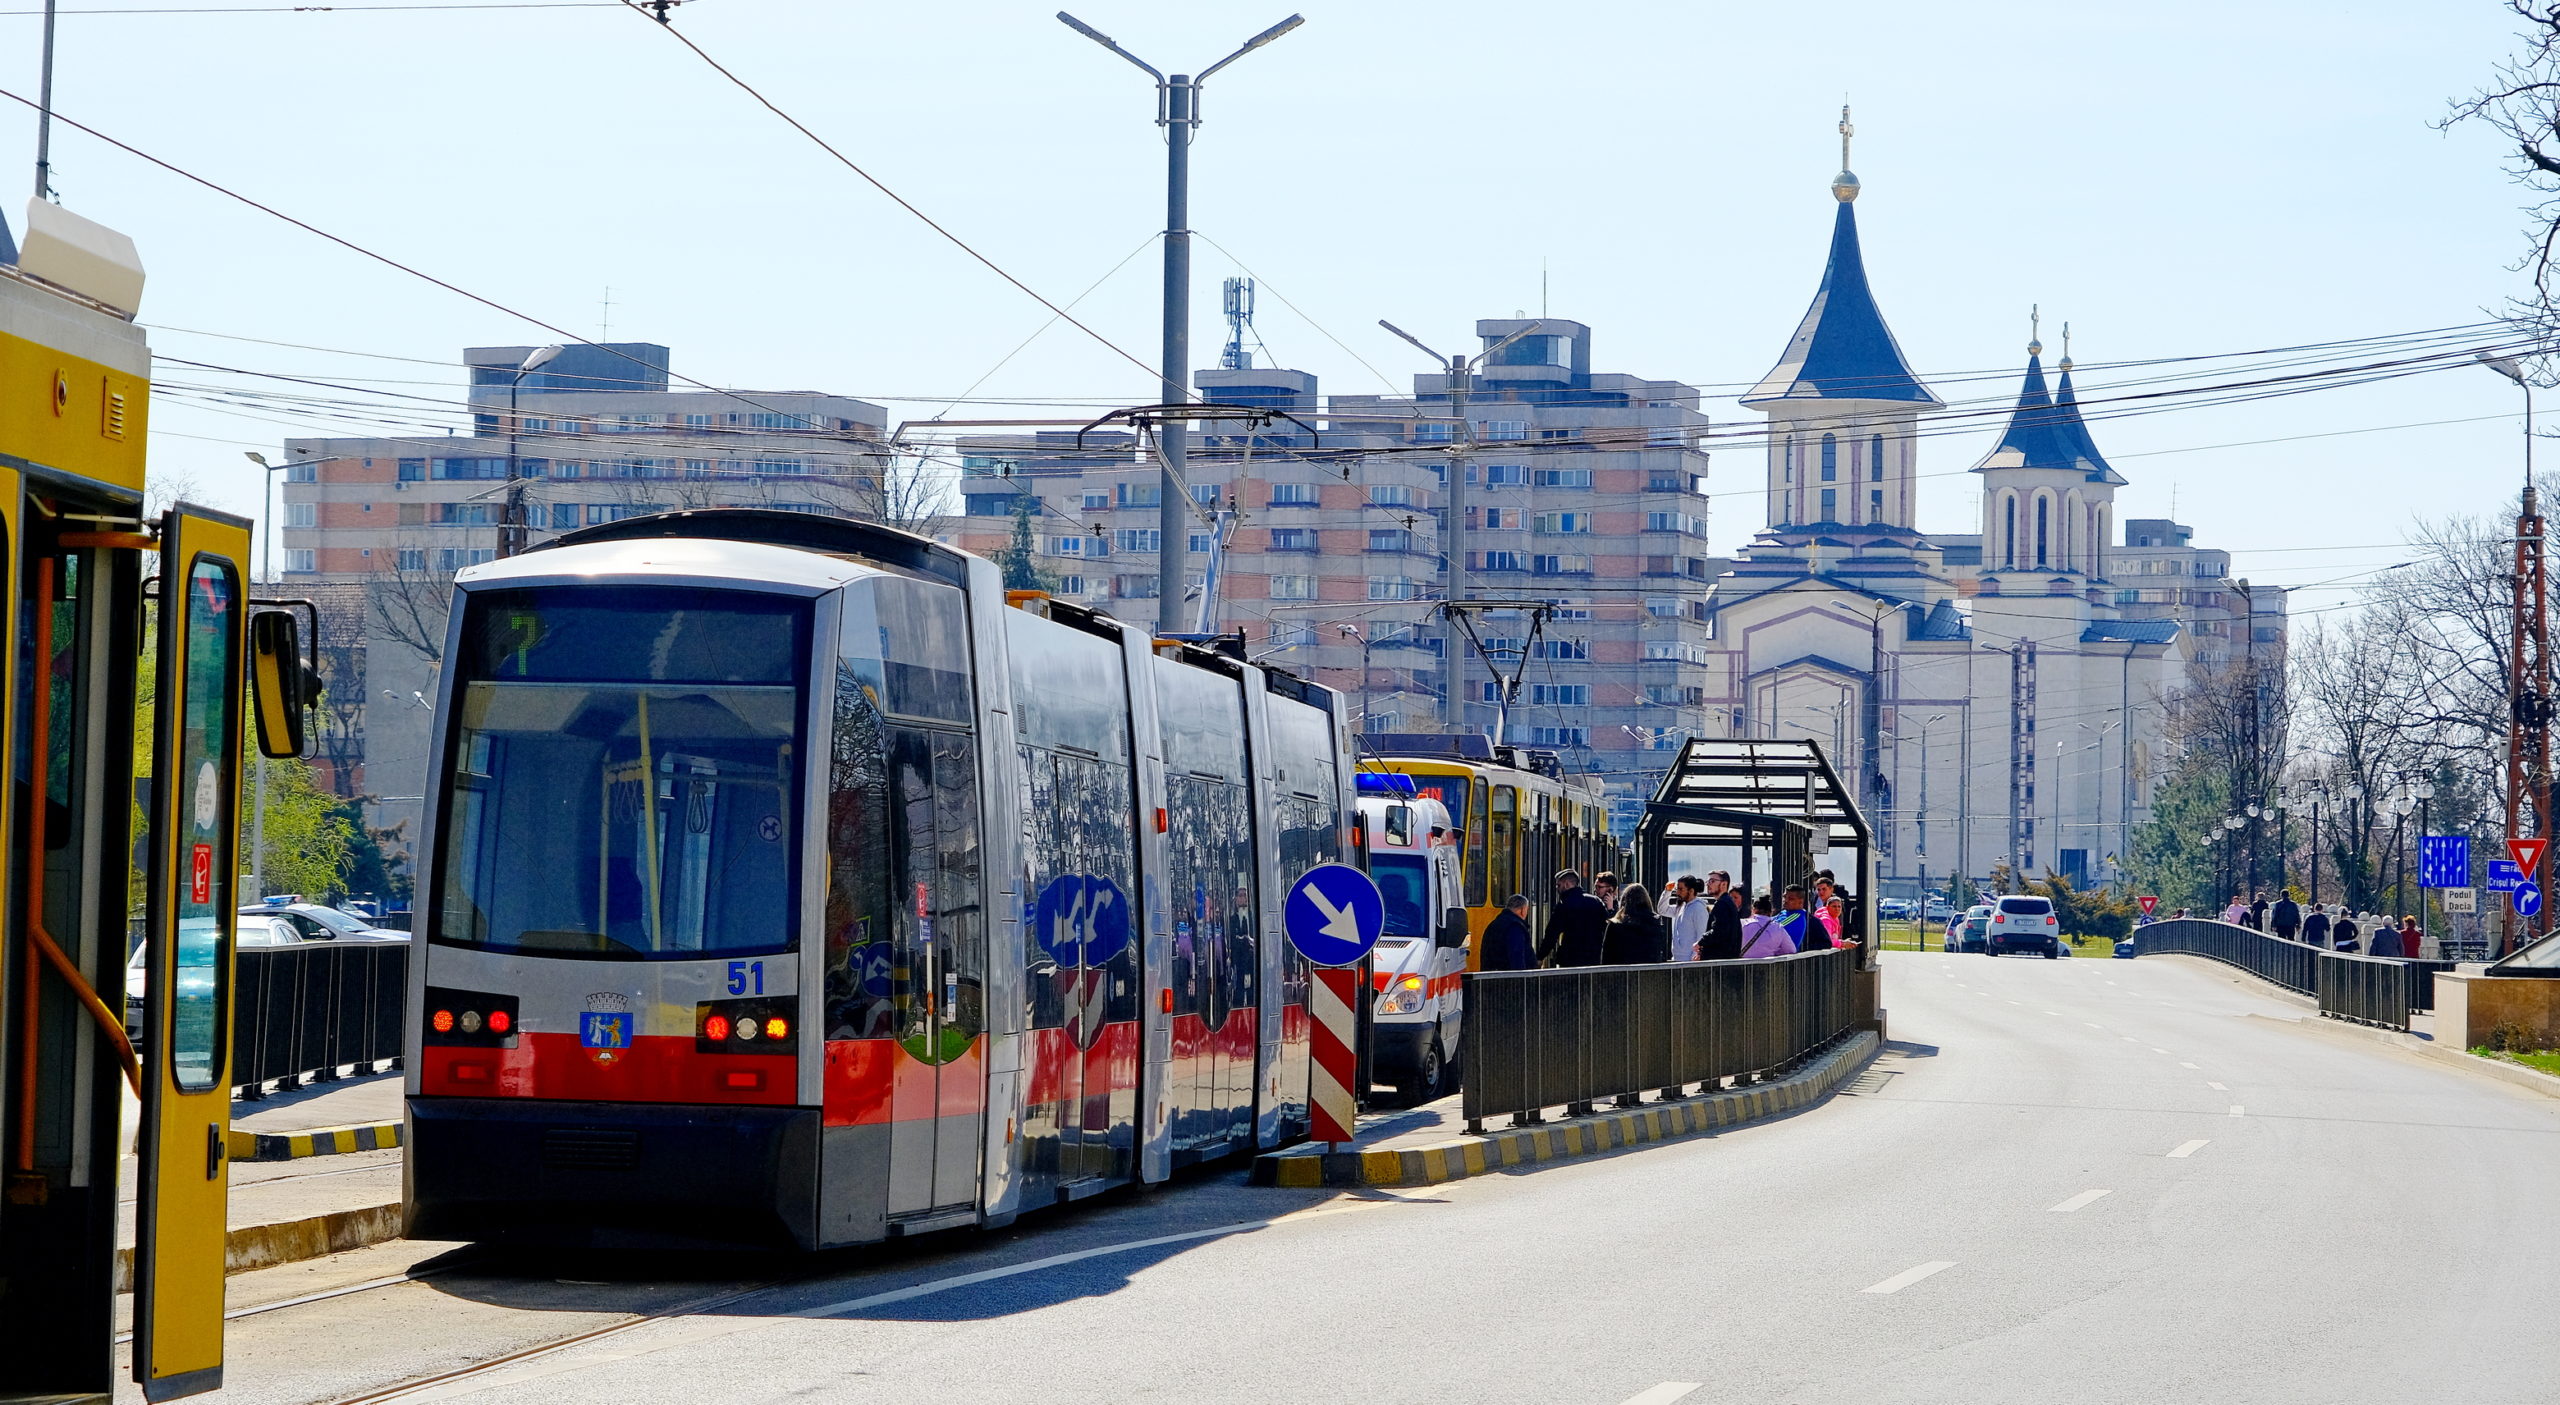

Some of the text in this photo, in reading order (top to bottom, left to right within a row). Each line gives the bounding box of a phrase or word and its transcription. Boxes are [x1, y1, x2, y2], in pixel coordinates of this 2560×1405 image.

[511, 616, 536, 676] 7
[2448, 890, 2472, 899] Podul
[2448, 902, 2472, 911] Dacia
[727, 961, 764, 996] 51
